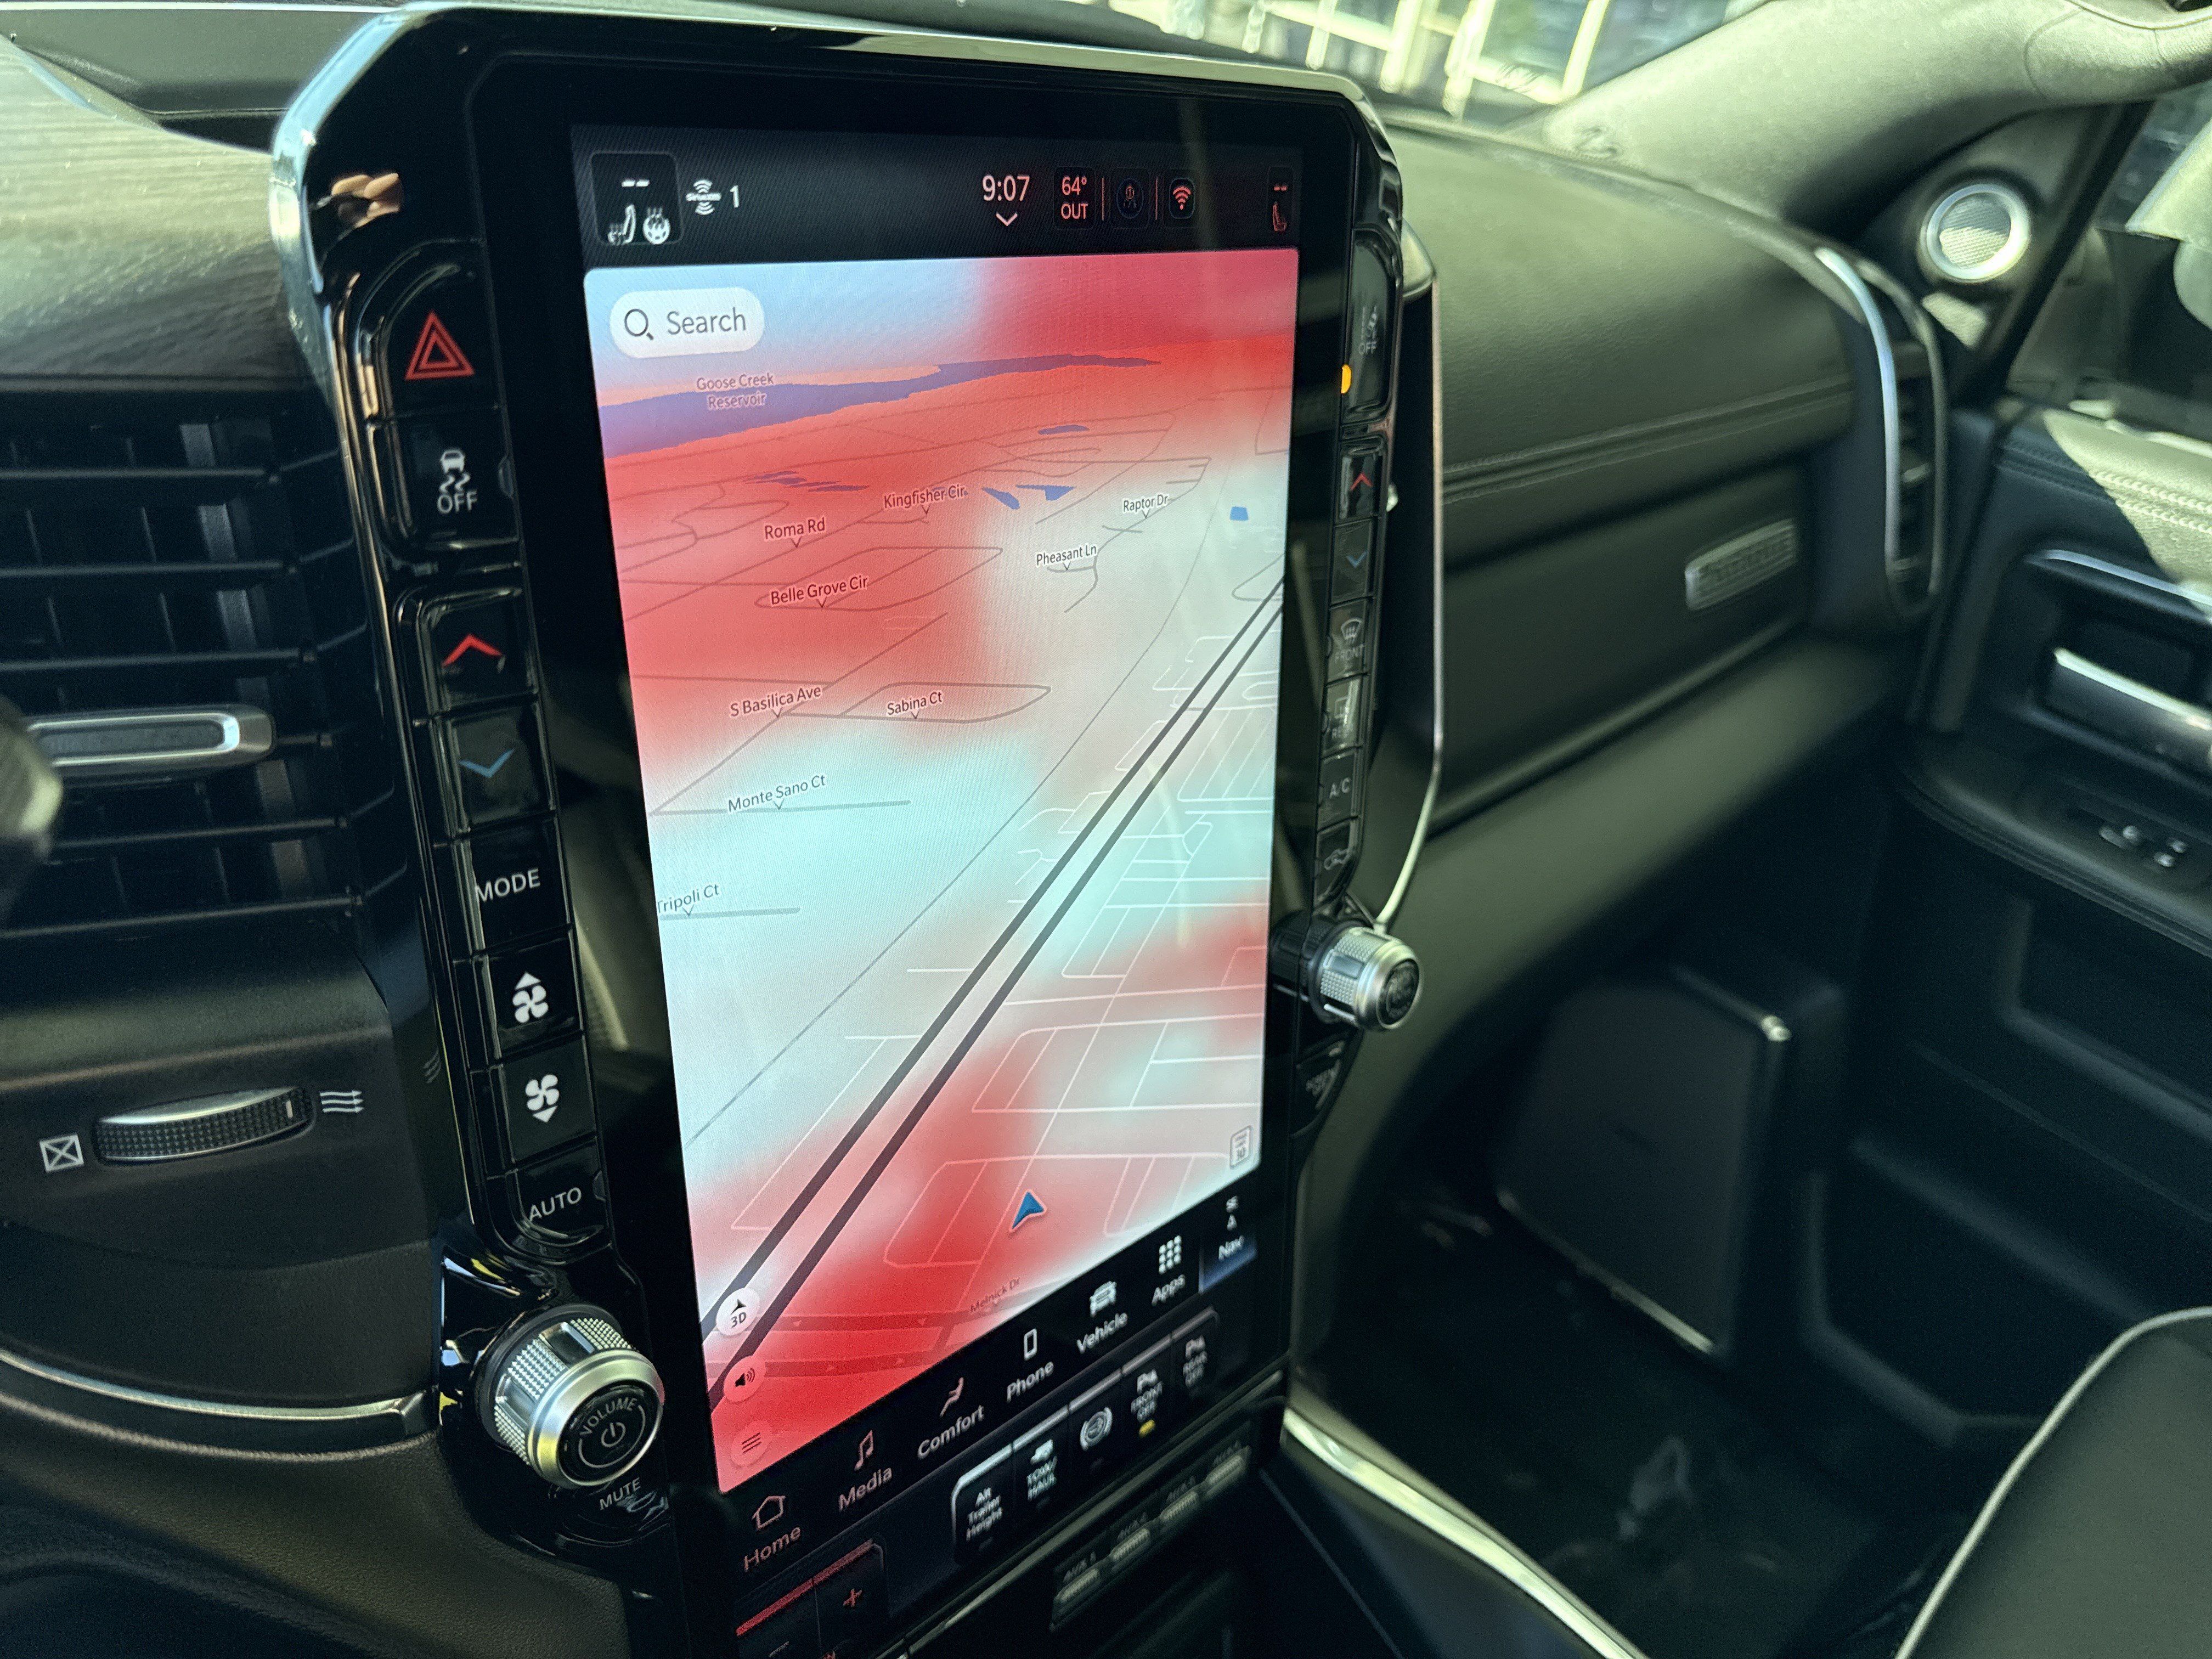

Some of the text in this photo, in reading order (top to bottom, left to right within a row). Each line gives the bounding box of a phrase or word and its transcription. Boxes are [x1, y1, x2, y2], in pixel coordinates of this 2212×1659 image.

[730, 185, 740, 208] 1
[982, 174, 1031, 201] 9:07
[1061, 176, 1087, 195] 64°
[1060, 203, 1088, 219] OUT
[667, 307, 747, 335] Search
[1358, 341, 1377, 355] OFF
[696, 373, 775, 391] Goose Creek
[708, 392, 766, 409] Reservoir
[437, 489, 478, 514] OFF
[884, 484, 966, 510] Kingfisher Cir
[1123, 494, 1169, 513] Raptor Dr
[764, 517, 826, 540] Roma Rd
[1036, 545, 1097, 566] Pheasant Ln
[771, 574, 869, 605] Belle Grove Cir
[730, 686, 821, 717] S Basilica Ave
[887, 691, 943, 716] Sabina Ct
[728, 774, 826, 812] Monte Sano Ct
[476, 867, 541, 903] MODE
[657, 883, 720, 914] Tripoli Ct
[529, 1187, 582, 1222] AUTO
[1218, 1234, 1245, 1261] Nav
[1152, 1274, 1186, 1306] Apps
[730, 1312, 747, 1328] 3D
[1076, 1312, 1128, 1355] Vehicle
[1006, 1361, 1054, 1403] Phone
[579, 1397, 639, 1436] VOLUME
[917, 1404, 985, 1460] Comfort
[599, 1477, 641, 1510] MUTE
[838, 1467, 893, 1513] Media
[966, 1506, 1003, 1543] Height
[744, 1526, 802, 1573] Home
